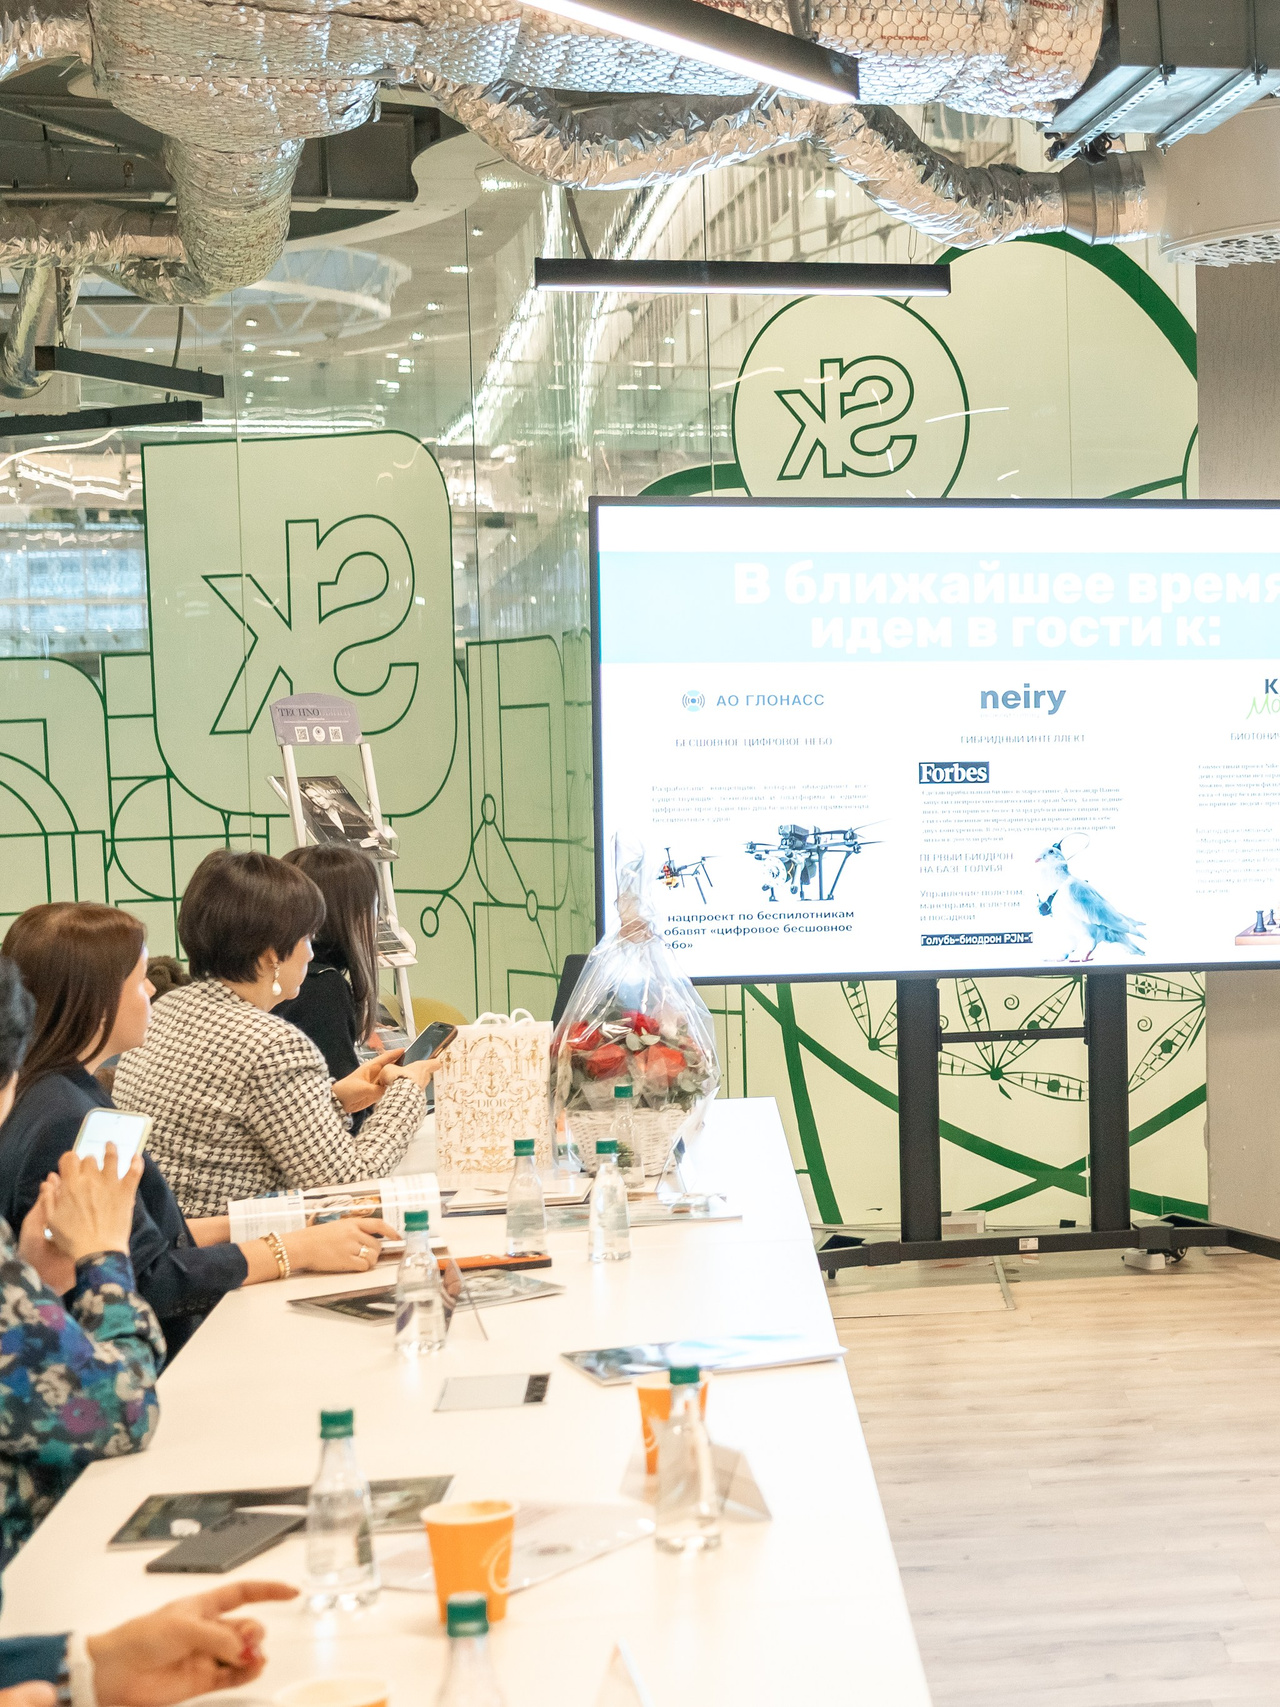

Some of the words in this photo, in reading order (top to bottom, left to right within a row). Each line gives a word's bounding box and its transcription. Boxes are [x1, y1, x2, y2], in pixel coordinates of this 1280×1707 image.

[733, 562, 771, 604] В
[784, 559, 1117, 604] ближайшее
[811, 615, 952, 654] идем
[967, 615, 998, 648] в
[1011, 615, 1162, 648] гости
[1176, 614, 1221, 647] к:
[716, 694, 740, 707] АО
[745, 693, 825, 707] ГЛОНАСС
[980, 682, 1067, 715] neiry
[277, 707, 320, 718] TECHNO
[920, 763, 988, 783] Forbes
[667, 913, 735, 924] нацпроект
[738, 912, 754, 921] по
[756, 910, 855, 921] беспилотникам
[663, 926, 707, 936] обавят
[710, 925, 780, 936] «цифровое
[783, 924, 853, 933] бесшовное
[664, 940, 694, 950] ебо»
[921, 934, 1002, 946] Голубь-биодрон
[476, 1098, 508, 1108] DIOR
